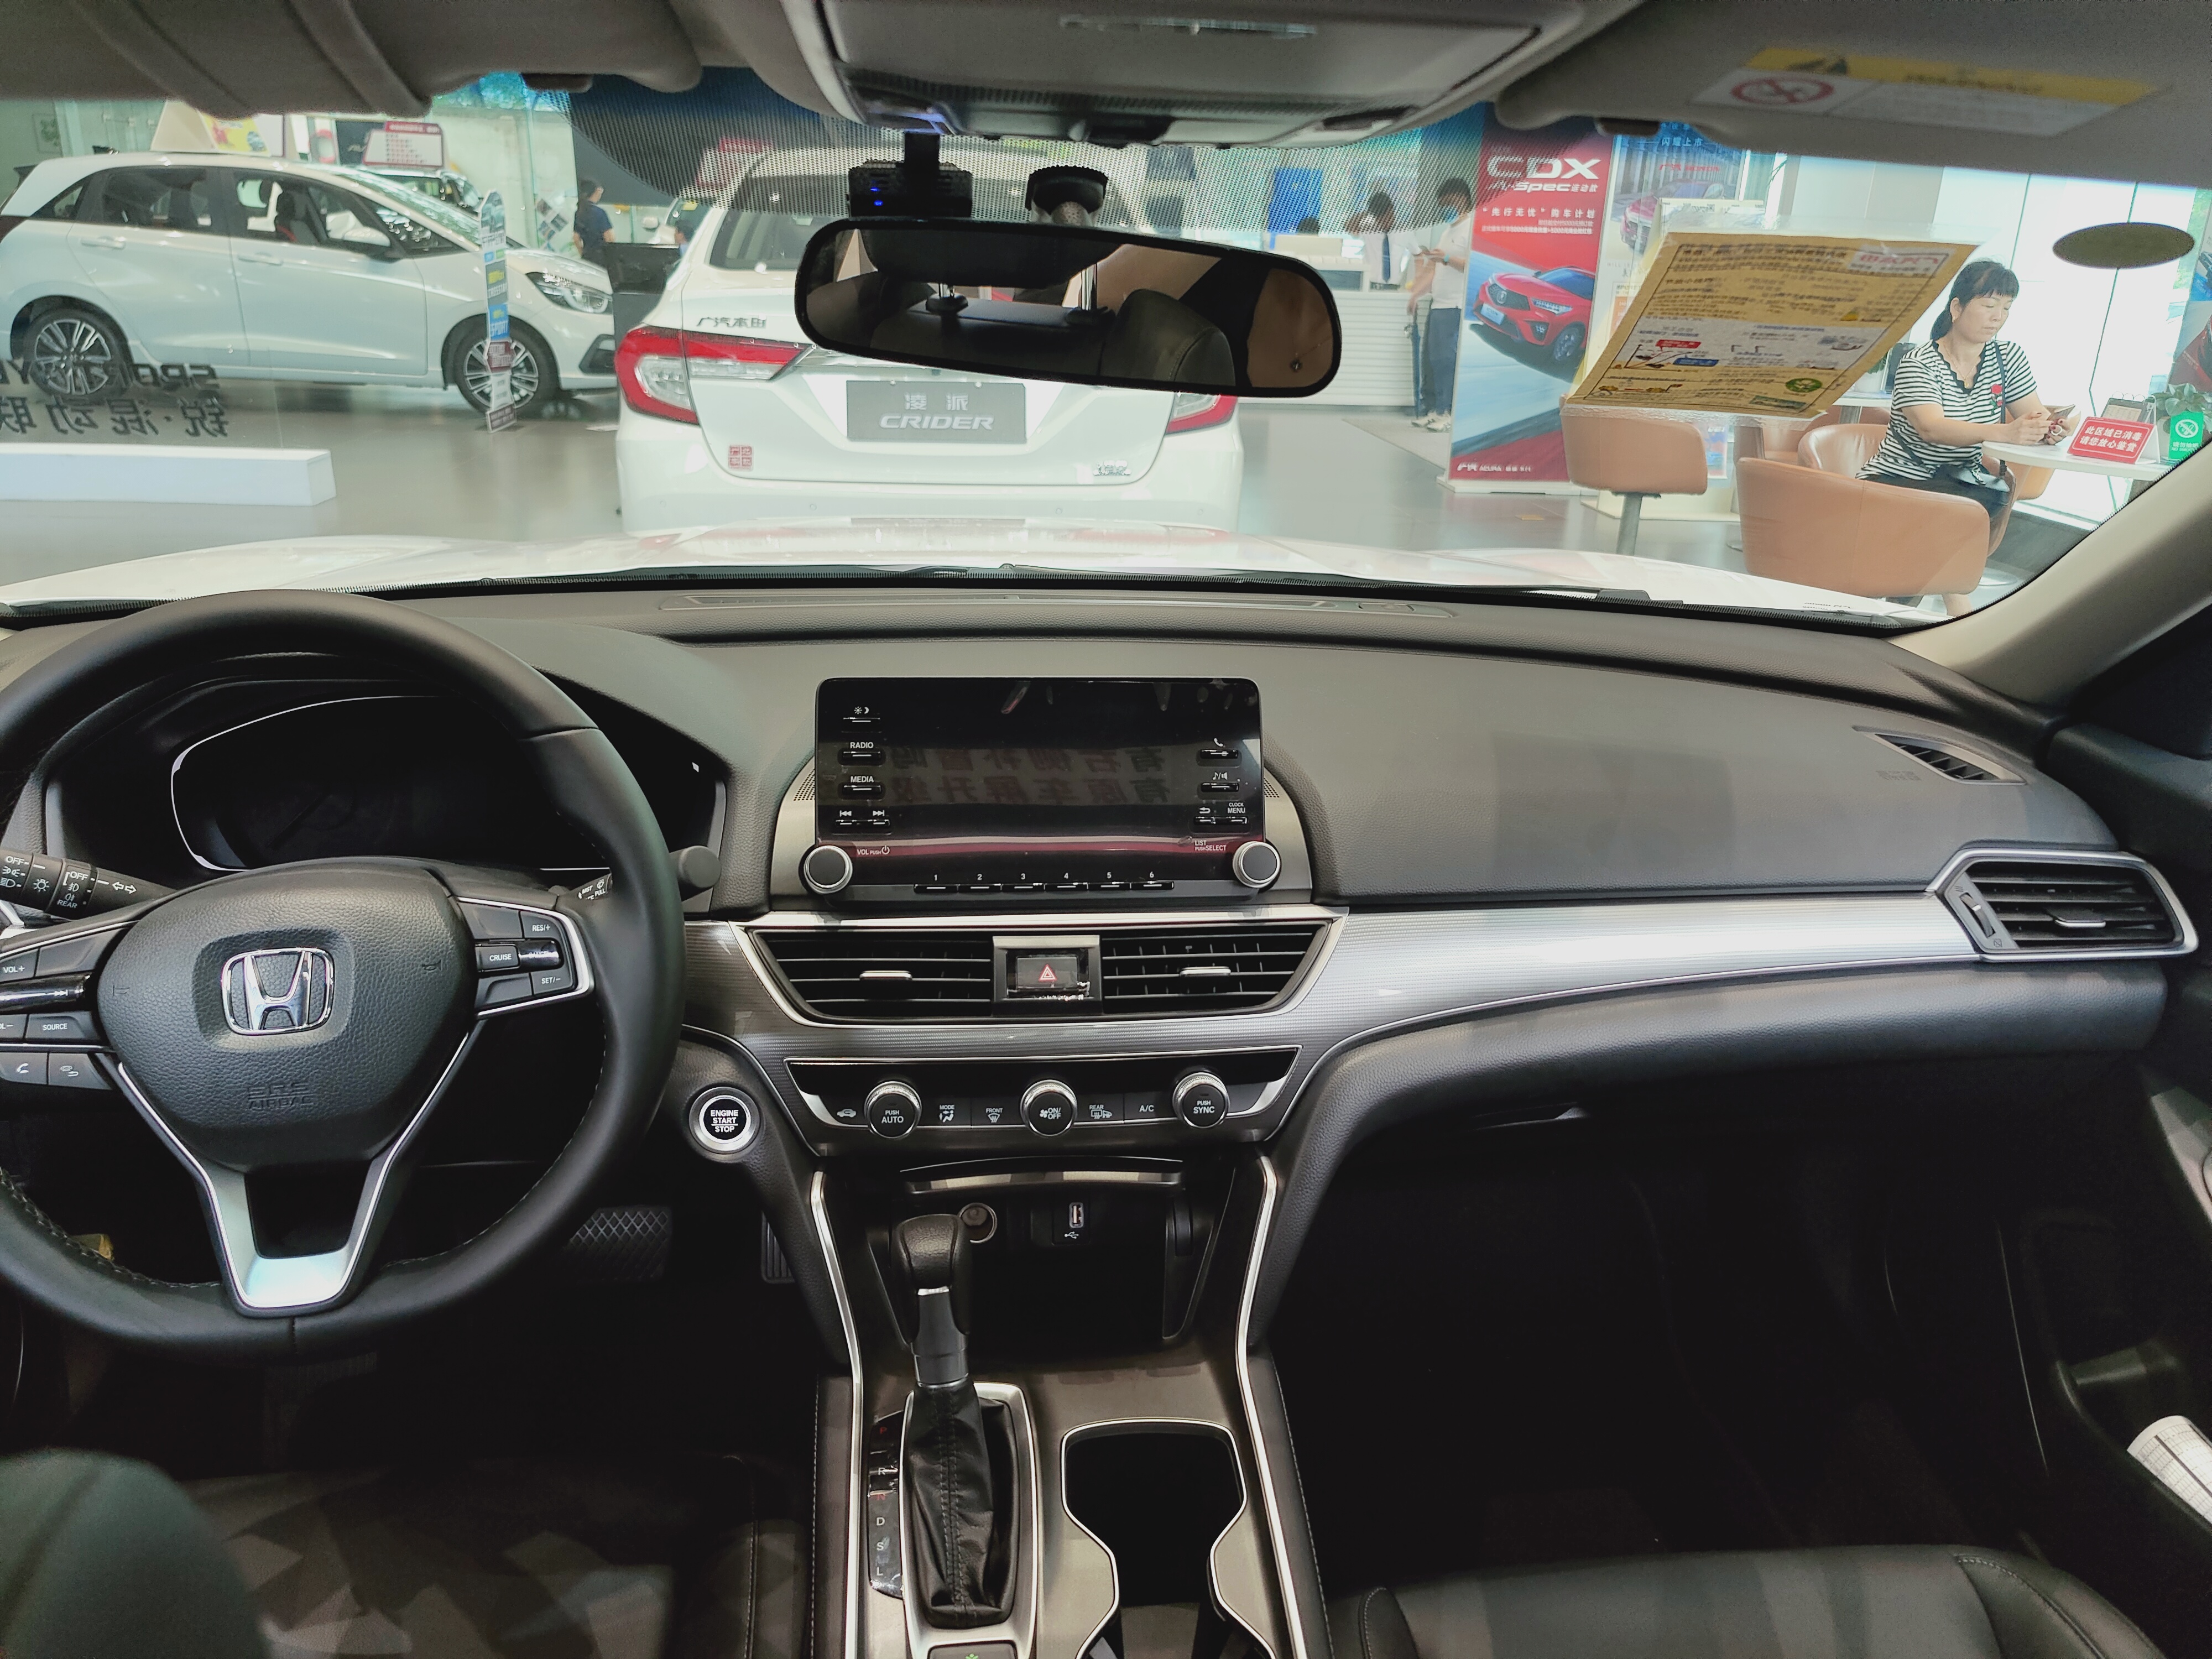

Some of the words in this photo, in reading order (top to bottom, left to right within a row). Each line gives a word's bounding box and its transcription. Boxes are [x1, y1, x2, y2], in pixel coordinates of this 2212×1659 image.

[1486, 155, 1601, 180] CDX
[696, 317, 766, 329] 广汽本田
[904, 392, 968, 411] 凌派
[880, 415, 994, 430] CRIDER
[2084, 425, 2143, 441] 此区域已消毒
[2080, 436, 2137, 452] 请您放心鉴赏
[6, 855, 25, 865] OFF
[70, 870, 89, 881] OFF
[594, 888, 606, 897] PULL
[57, 899, 77, 909] REAR
[878, 1467, 886, 1475] R
[877, 1517, 885, 1526] D
[877, 1541, 884, 1551] S
[877, 1566, 884, 1576] L
